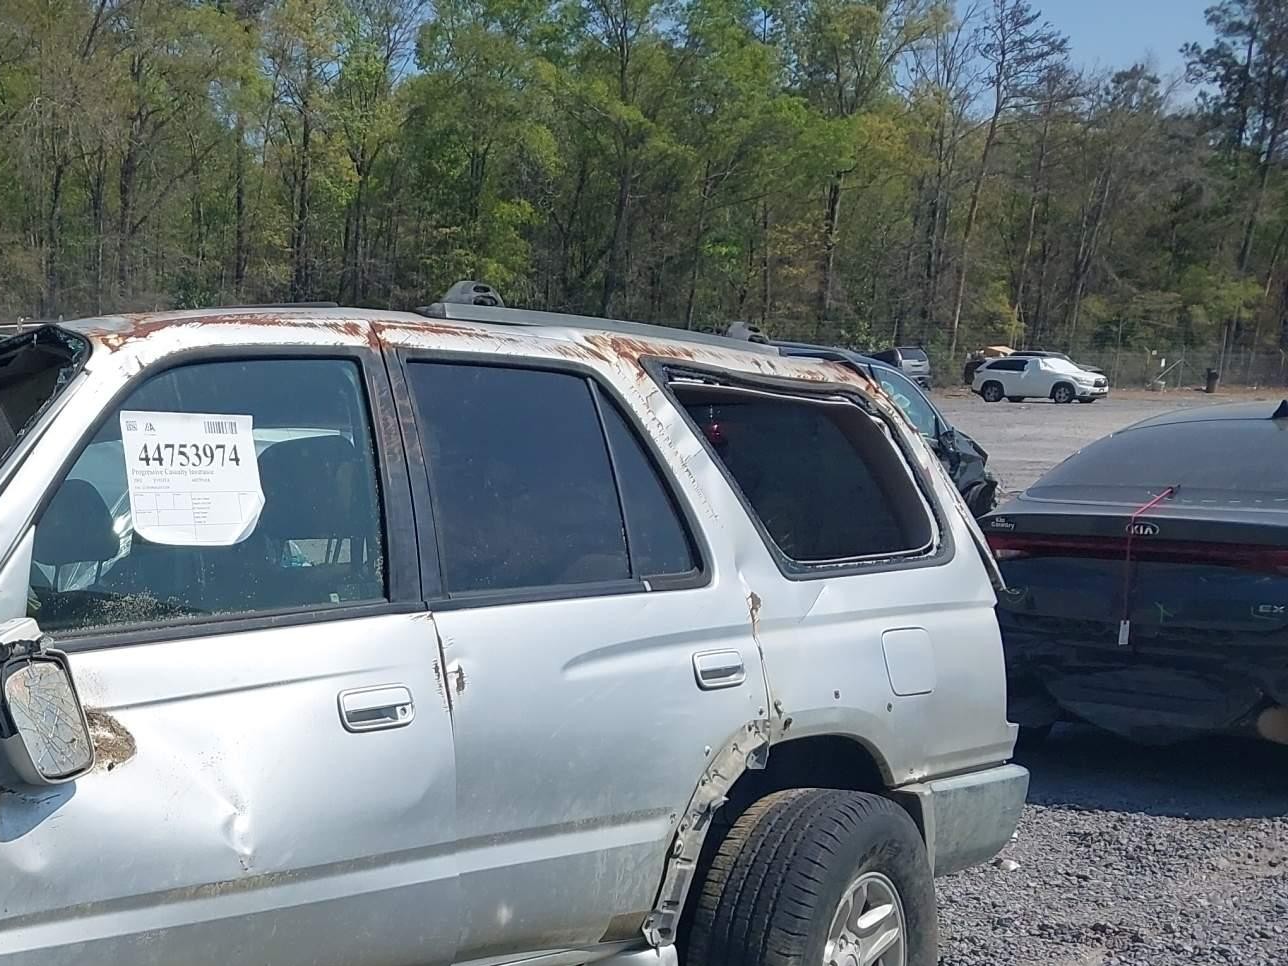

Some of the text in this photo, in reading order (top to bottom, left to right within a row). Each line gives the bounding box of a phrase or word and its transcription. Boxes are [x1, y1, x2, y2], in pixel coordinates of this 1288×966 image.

[139, 443, 241, 467] 44753974
[1131, 524, 1154, 535] KIA
[1259, 604, 1285, 613] EX
